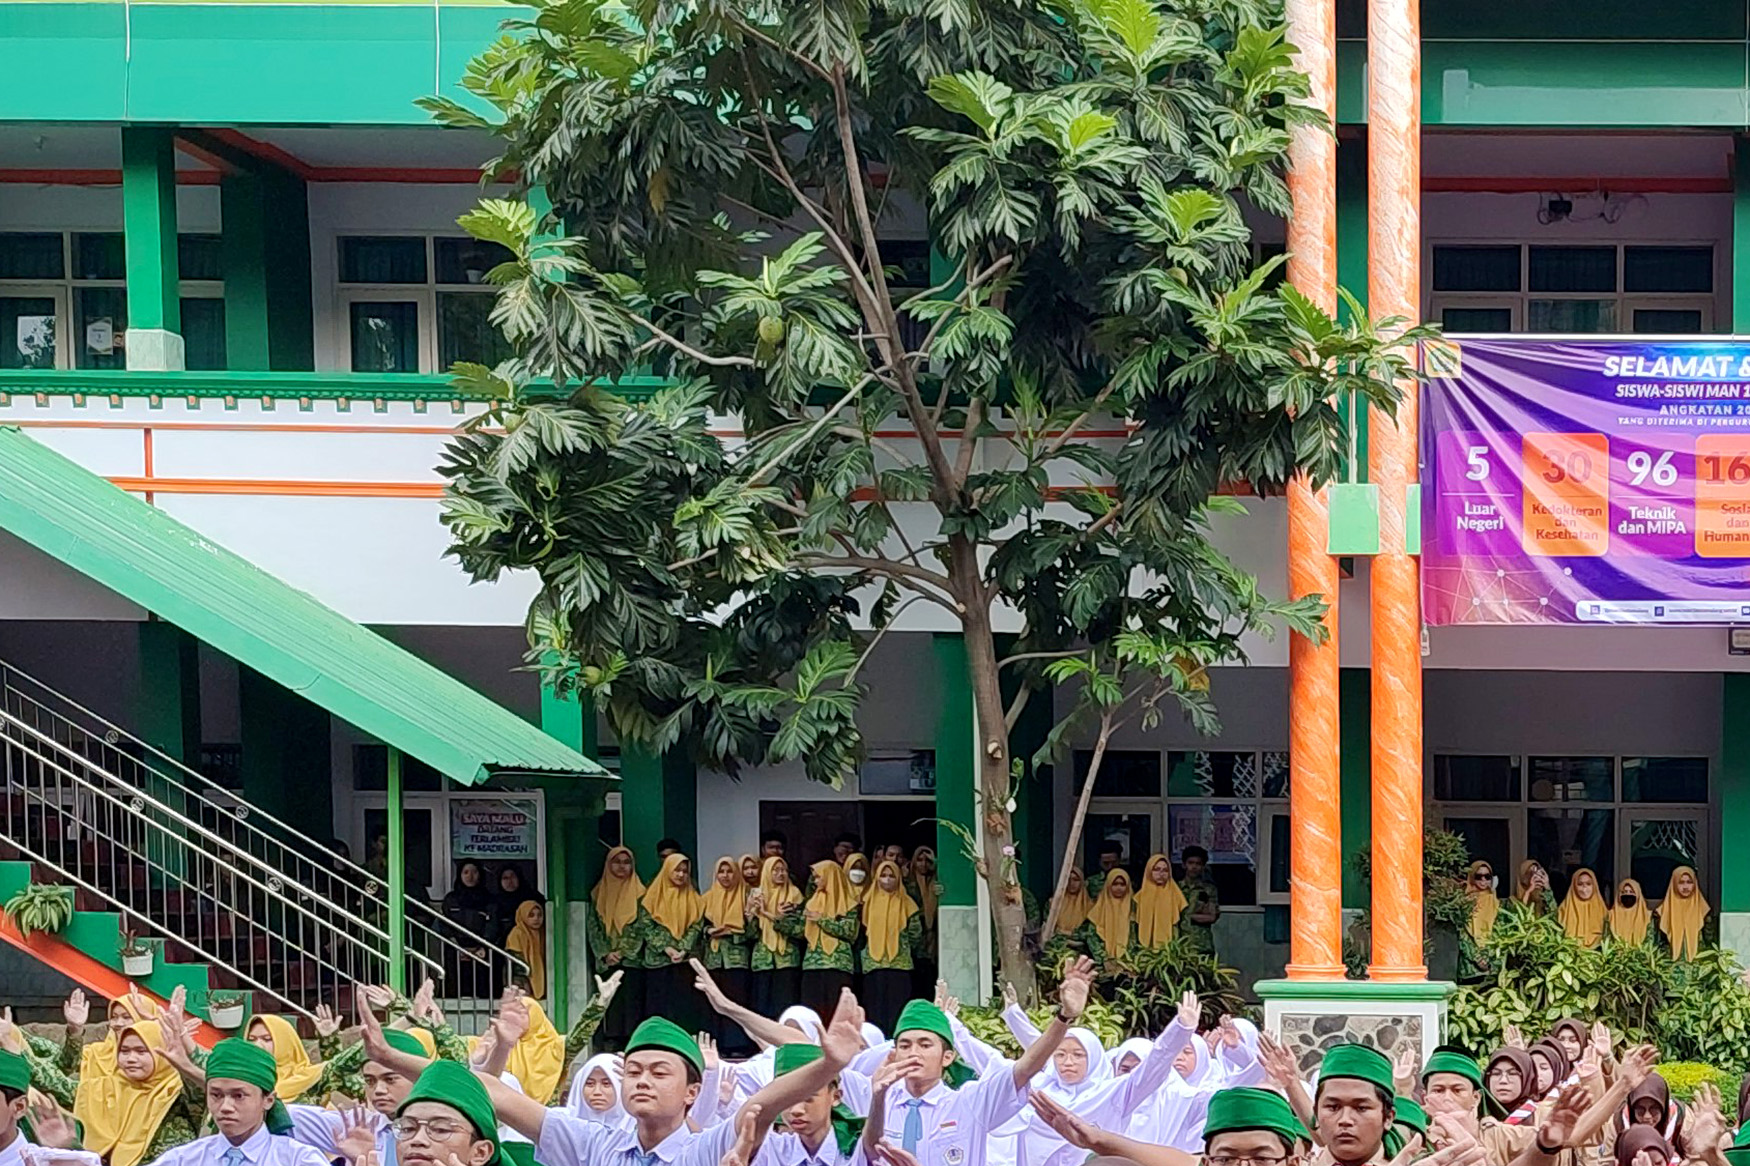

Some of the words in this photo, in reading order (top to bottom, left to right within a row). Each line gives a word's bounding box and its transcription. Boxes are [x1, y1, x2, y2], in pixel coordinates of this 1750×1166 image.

[1603, 355, 1734, 377] SELAMAT
[1615, 383, 1704, 399] SISWA-SISWI
[1706, 384, 1741, 398] MAN
[1660, 404, 1733, 415] ANGKATAN
[1618, 417, 1644, 425] YANG
[1646, 417, 1694, 426] DITERIMA
[1697, 418, 1708, 426] DI
[1465, 446, 1490, 481] 5
[1542, 449, 1592, 484] 30
[1627, 451, 1678, 486] 96
[1465, 501, 1496, 515] Luar
[1532, 504, 1603, 516] Kedokteran
[1629, 506, 1677, 520] Teknik
[1457, 516, 1504, 531] Negeri
[1555, 517, 1577, 528] dan
[1618, 520, 1646, 534] dan
[1647, 521, 1687, 535] MIPA
[1726, 517, 1750, 528] dan
[1536, 529, 1599, 541] Kesehatan
